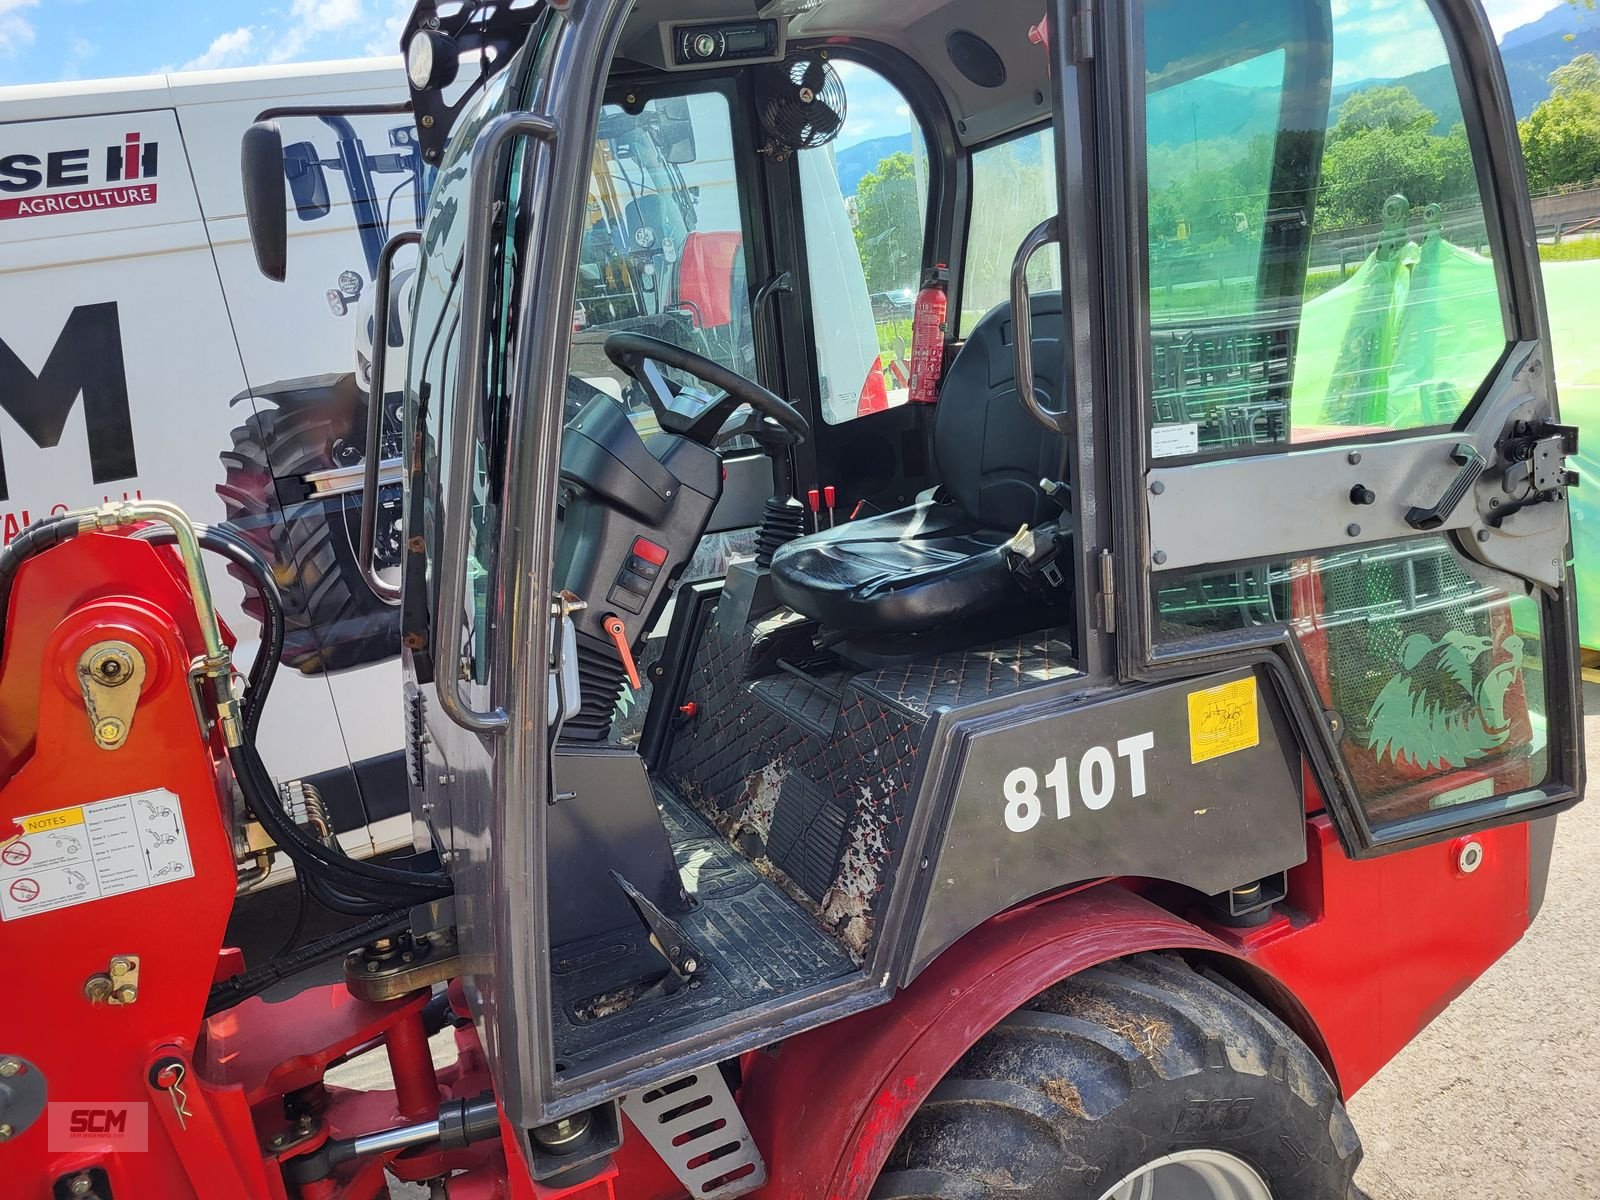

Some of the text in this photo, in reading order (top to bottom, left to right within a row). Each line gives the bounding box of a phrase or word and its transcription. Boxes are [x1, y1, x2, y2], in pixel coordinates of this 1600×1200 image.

[18, 187, 152, 215] AGRICULTURE
[1003, 731, 1154, 833] 810T
[28, 815, 67, 831] NOTES
